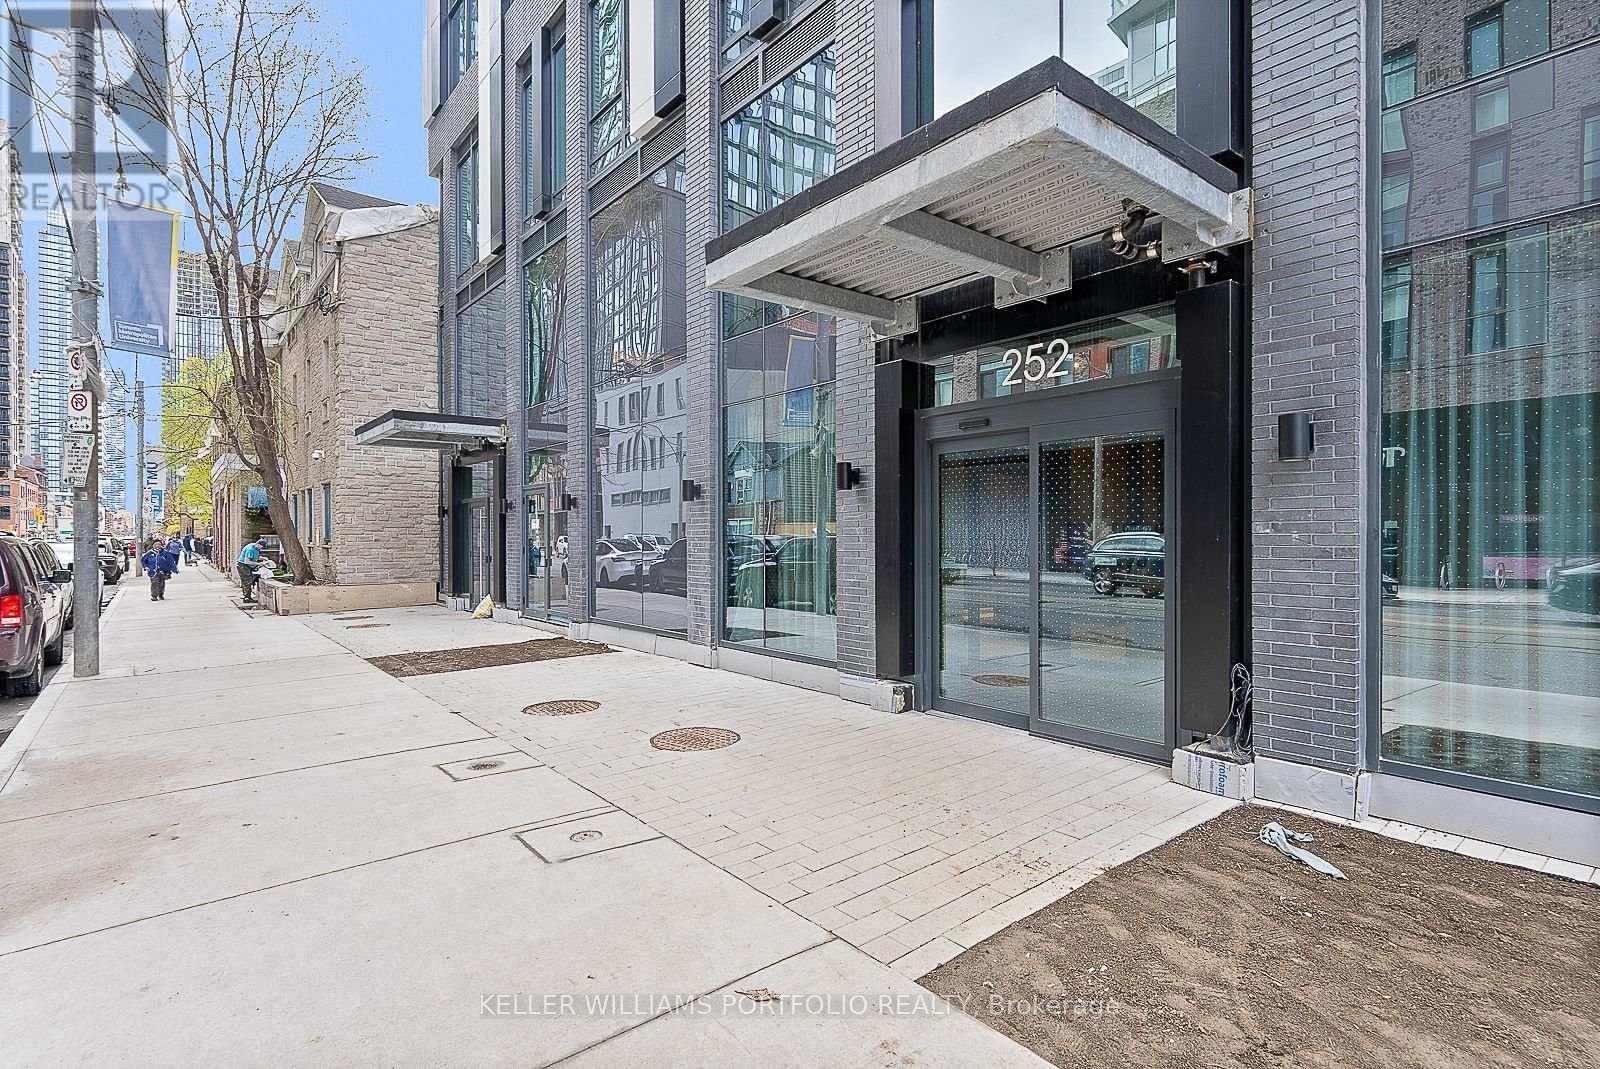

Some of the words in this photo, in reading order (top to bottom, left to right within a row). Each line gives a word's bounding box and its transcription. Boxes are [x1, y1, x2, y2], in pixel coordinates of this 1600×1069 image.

[118, 334, 151, 344] University
[1002, 338, 1069, 386] 252
[147, 461, 158, 486] TMU
